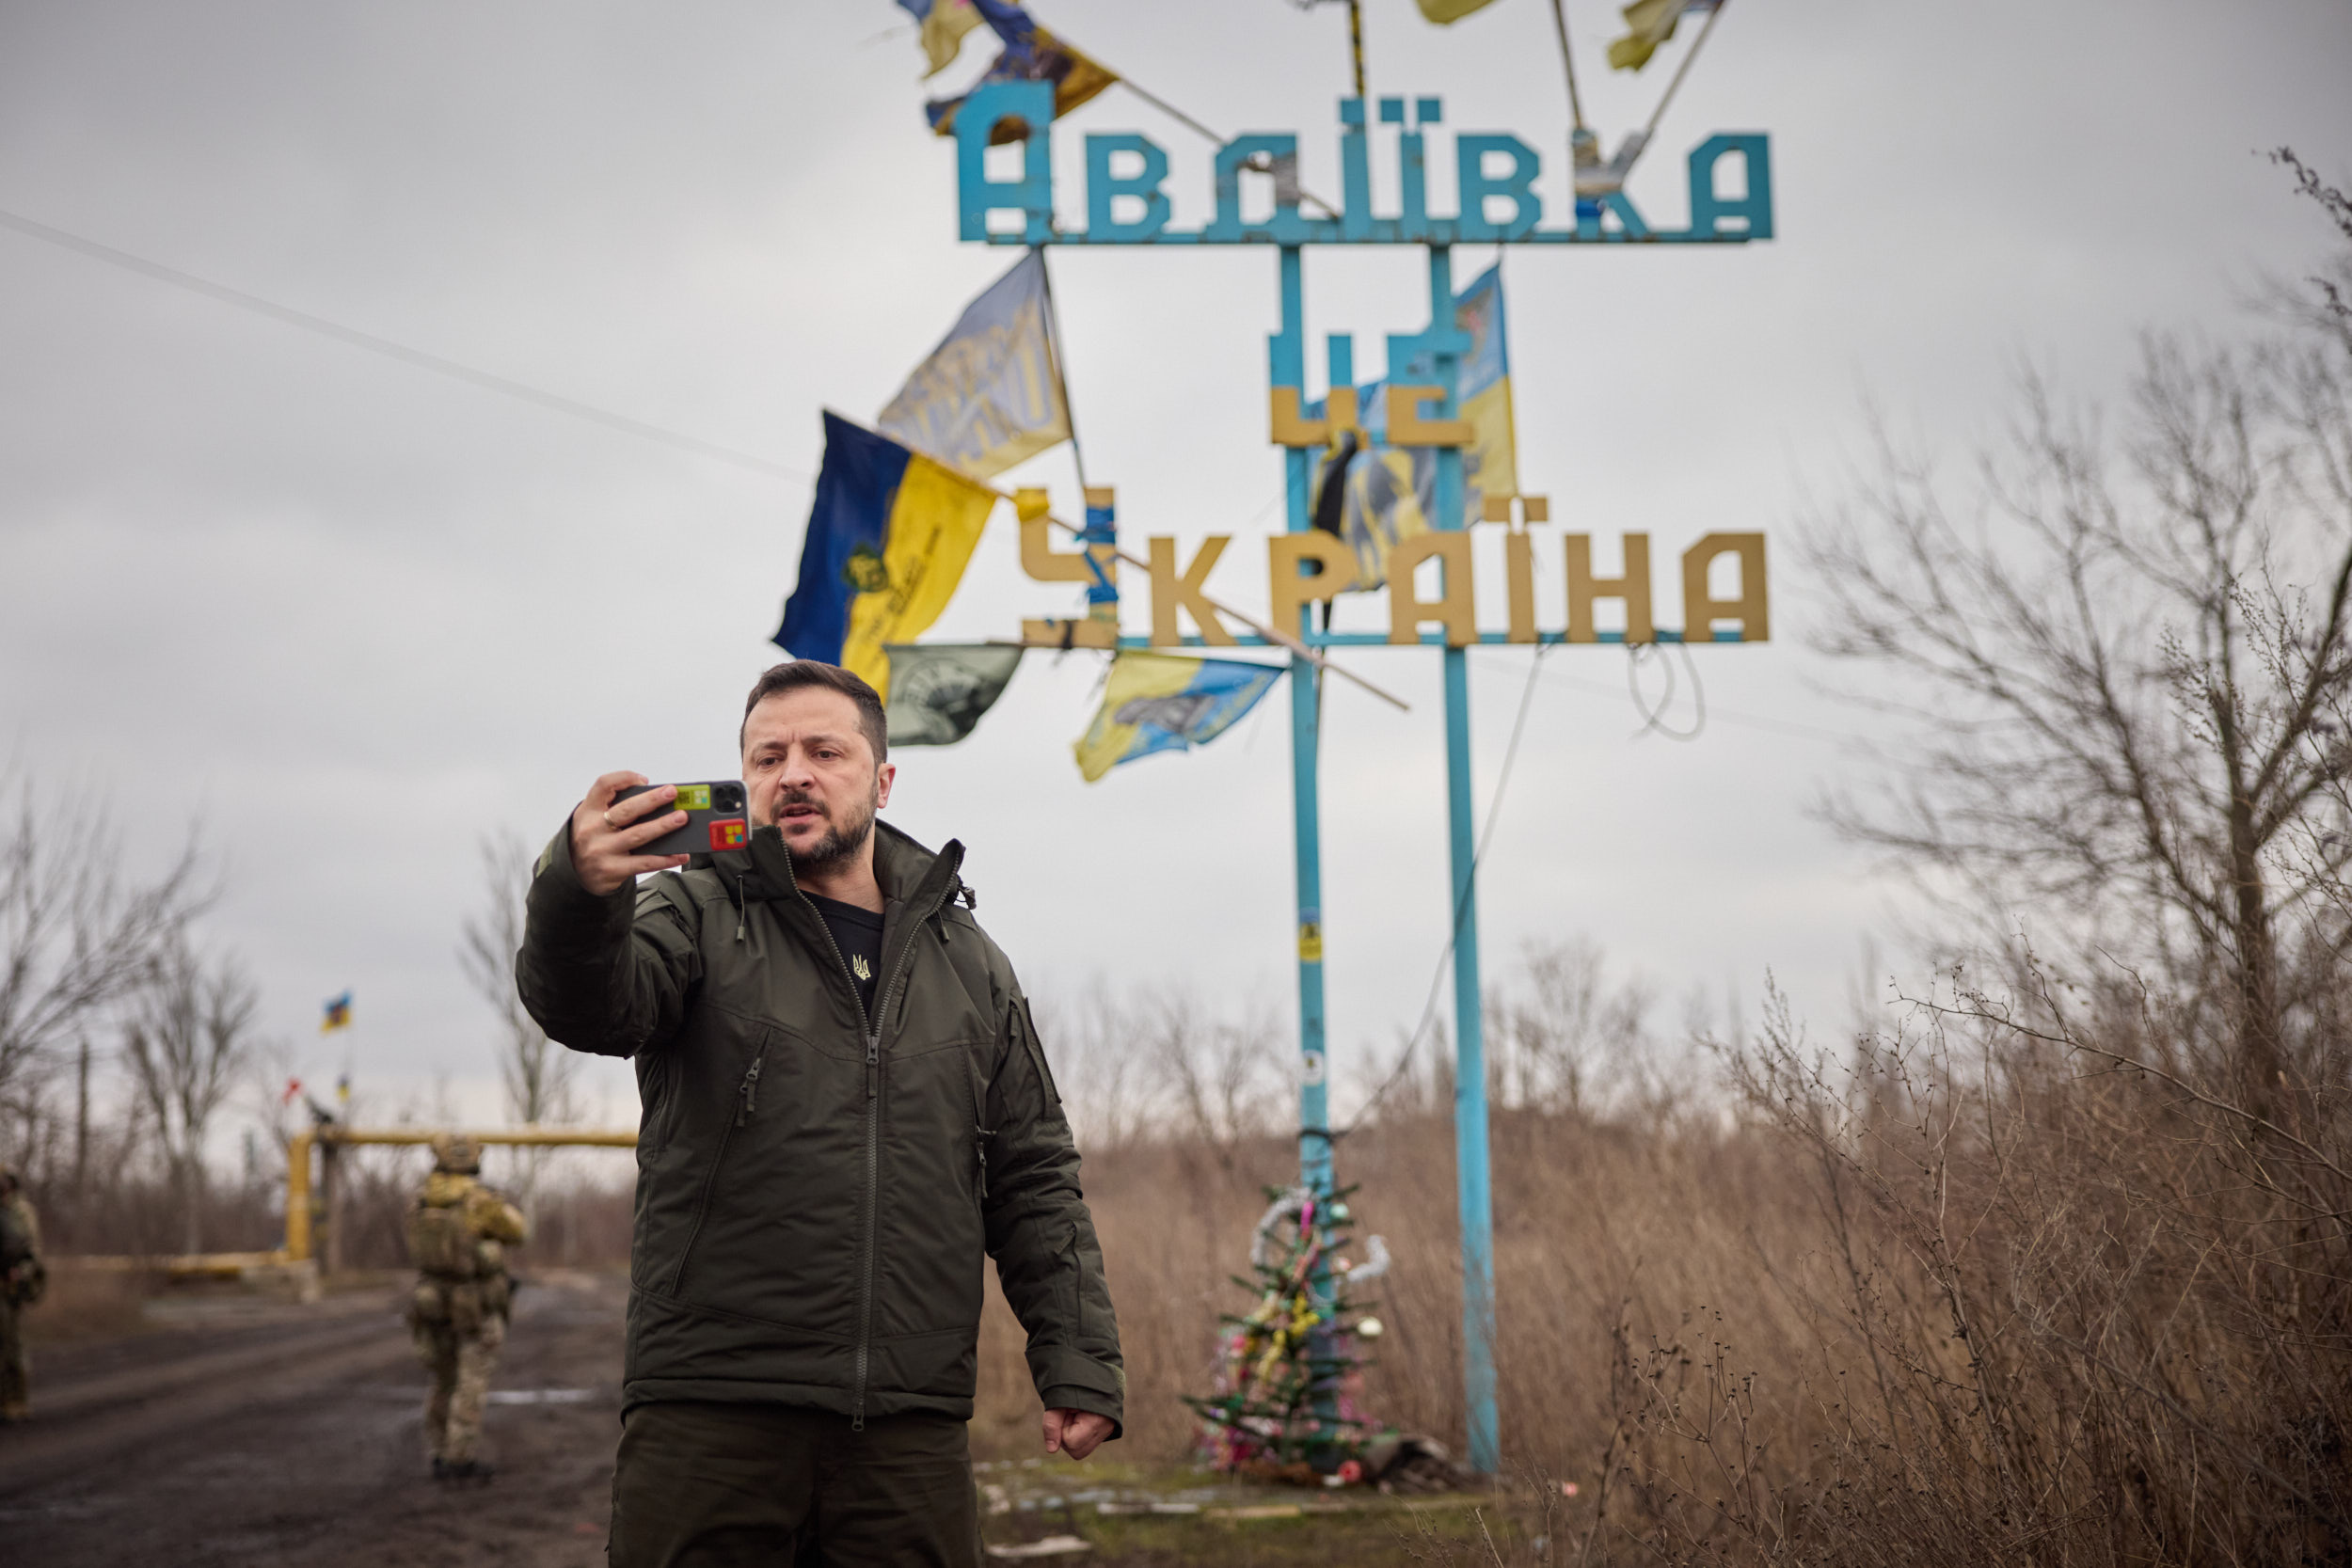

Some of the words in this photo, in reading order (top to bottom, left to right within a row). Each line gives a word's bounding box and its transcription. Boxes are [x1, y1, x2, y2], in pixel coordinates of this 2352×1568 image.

[955, 81, 1773, 242] АВДІЇВКА
[1268, 334, 1474, 450] ЦЕ
[1017, 486, 1770, 648] УКРАЇНА
